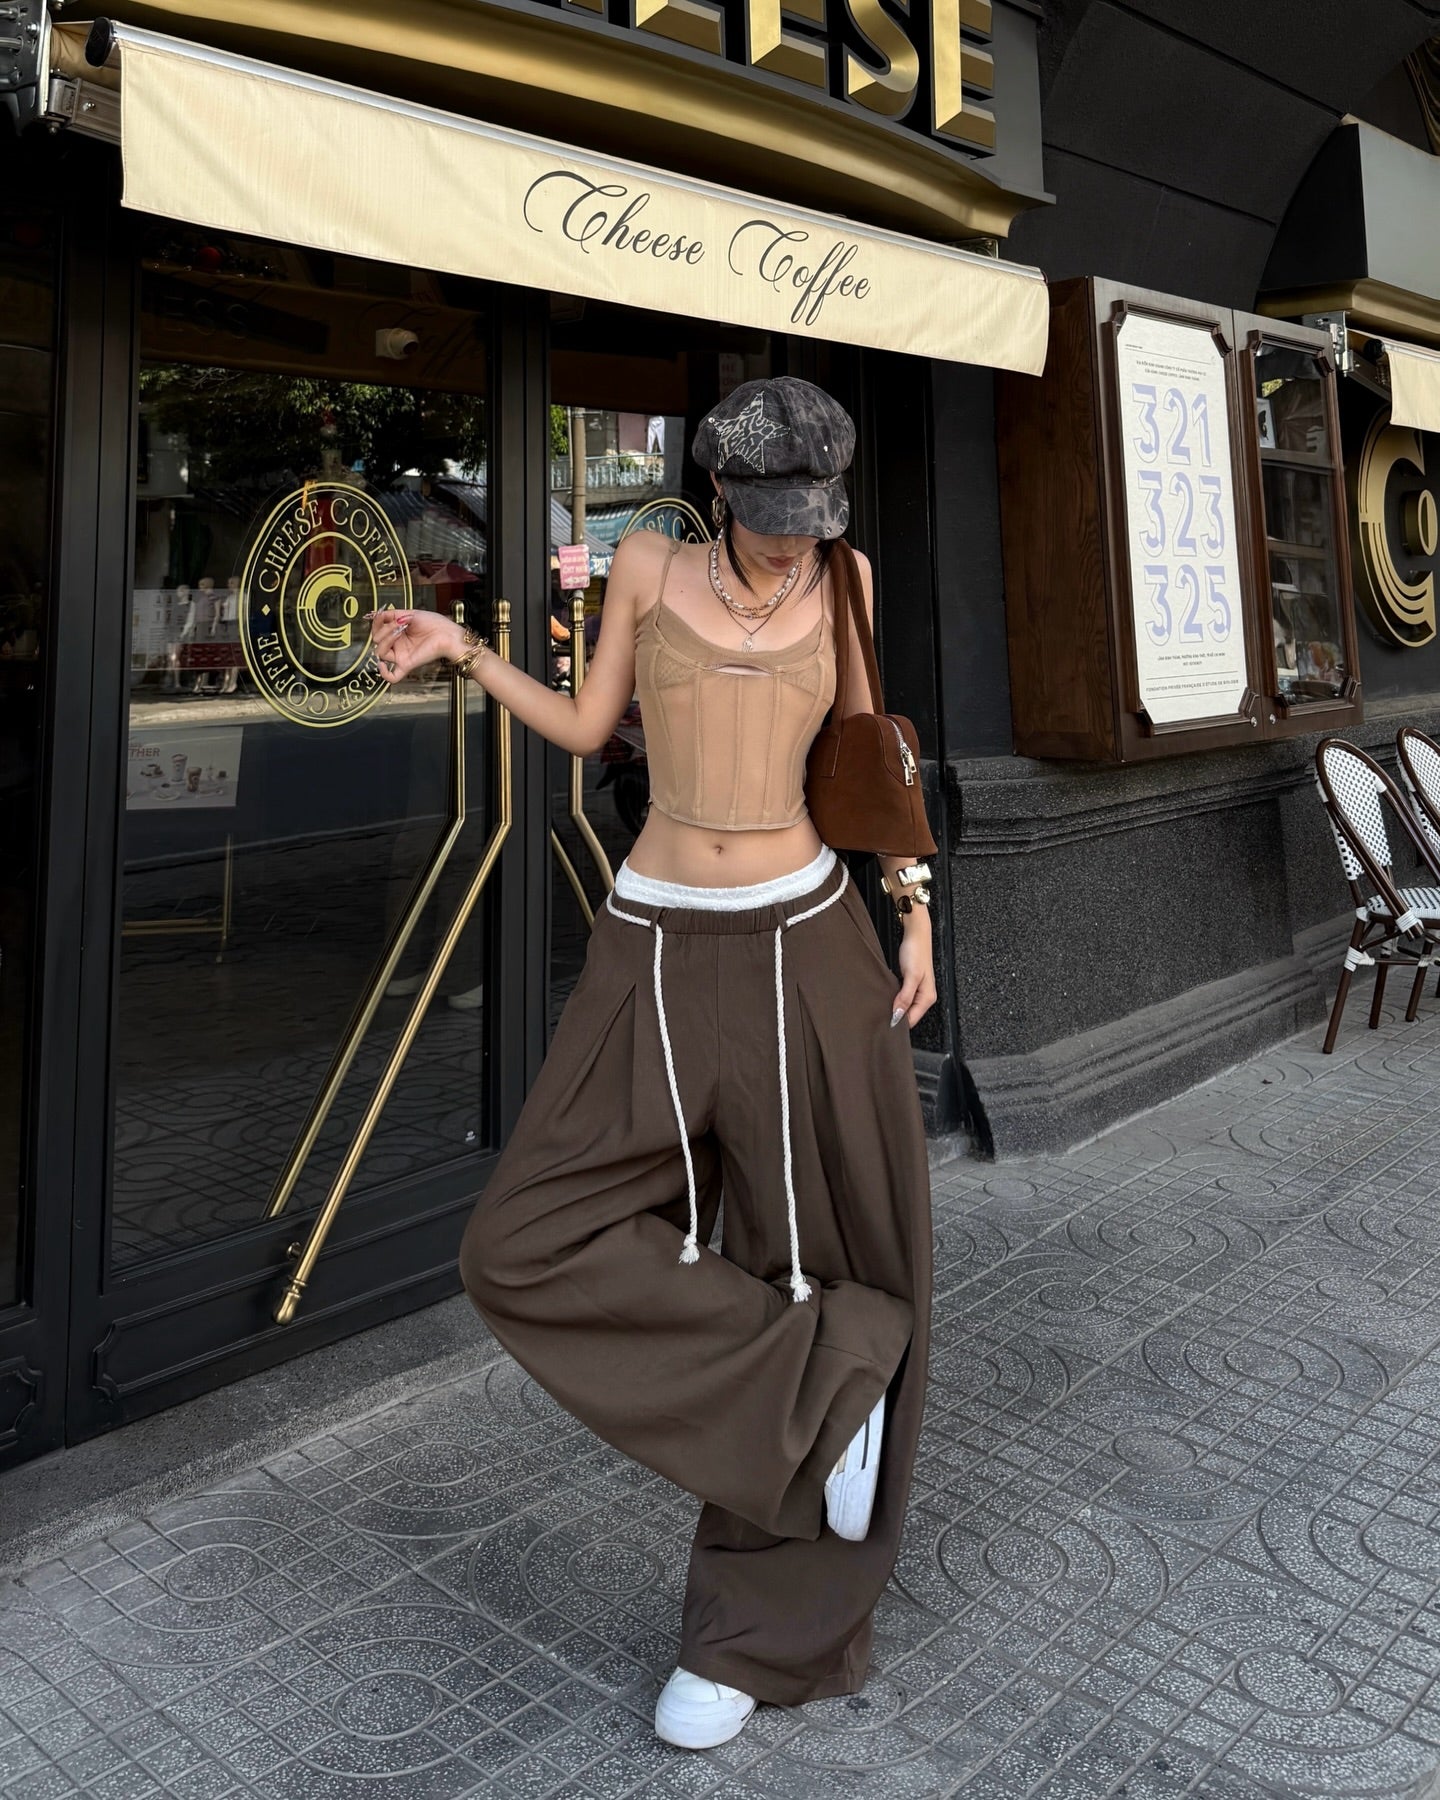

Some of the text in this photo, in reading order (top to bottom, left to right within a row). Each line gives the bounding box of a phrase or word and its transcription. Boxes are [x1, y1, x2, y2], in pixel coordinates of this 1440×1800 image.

[523, 170, 871, 326] Cheese Coffee
[1132, 383, 1212, 467] 321
[258, 497, 398, 593] CHEESE COFFEE
[1137, 470, 1225, 559] 323
[1144, 564, 1231, 646] 325
[257, 632, 329, 715] COFFEE
